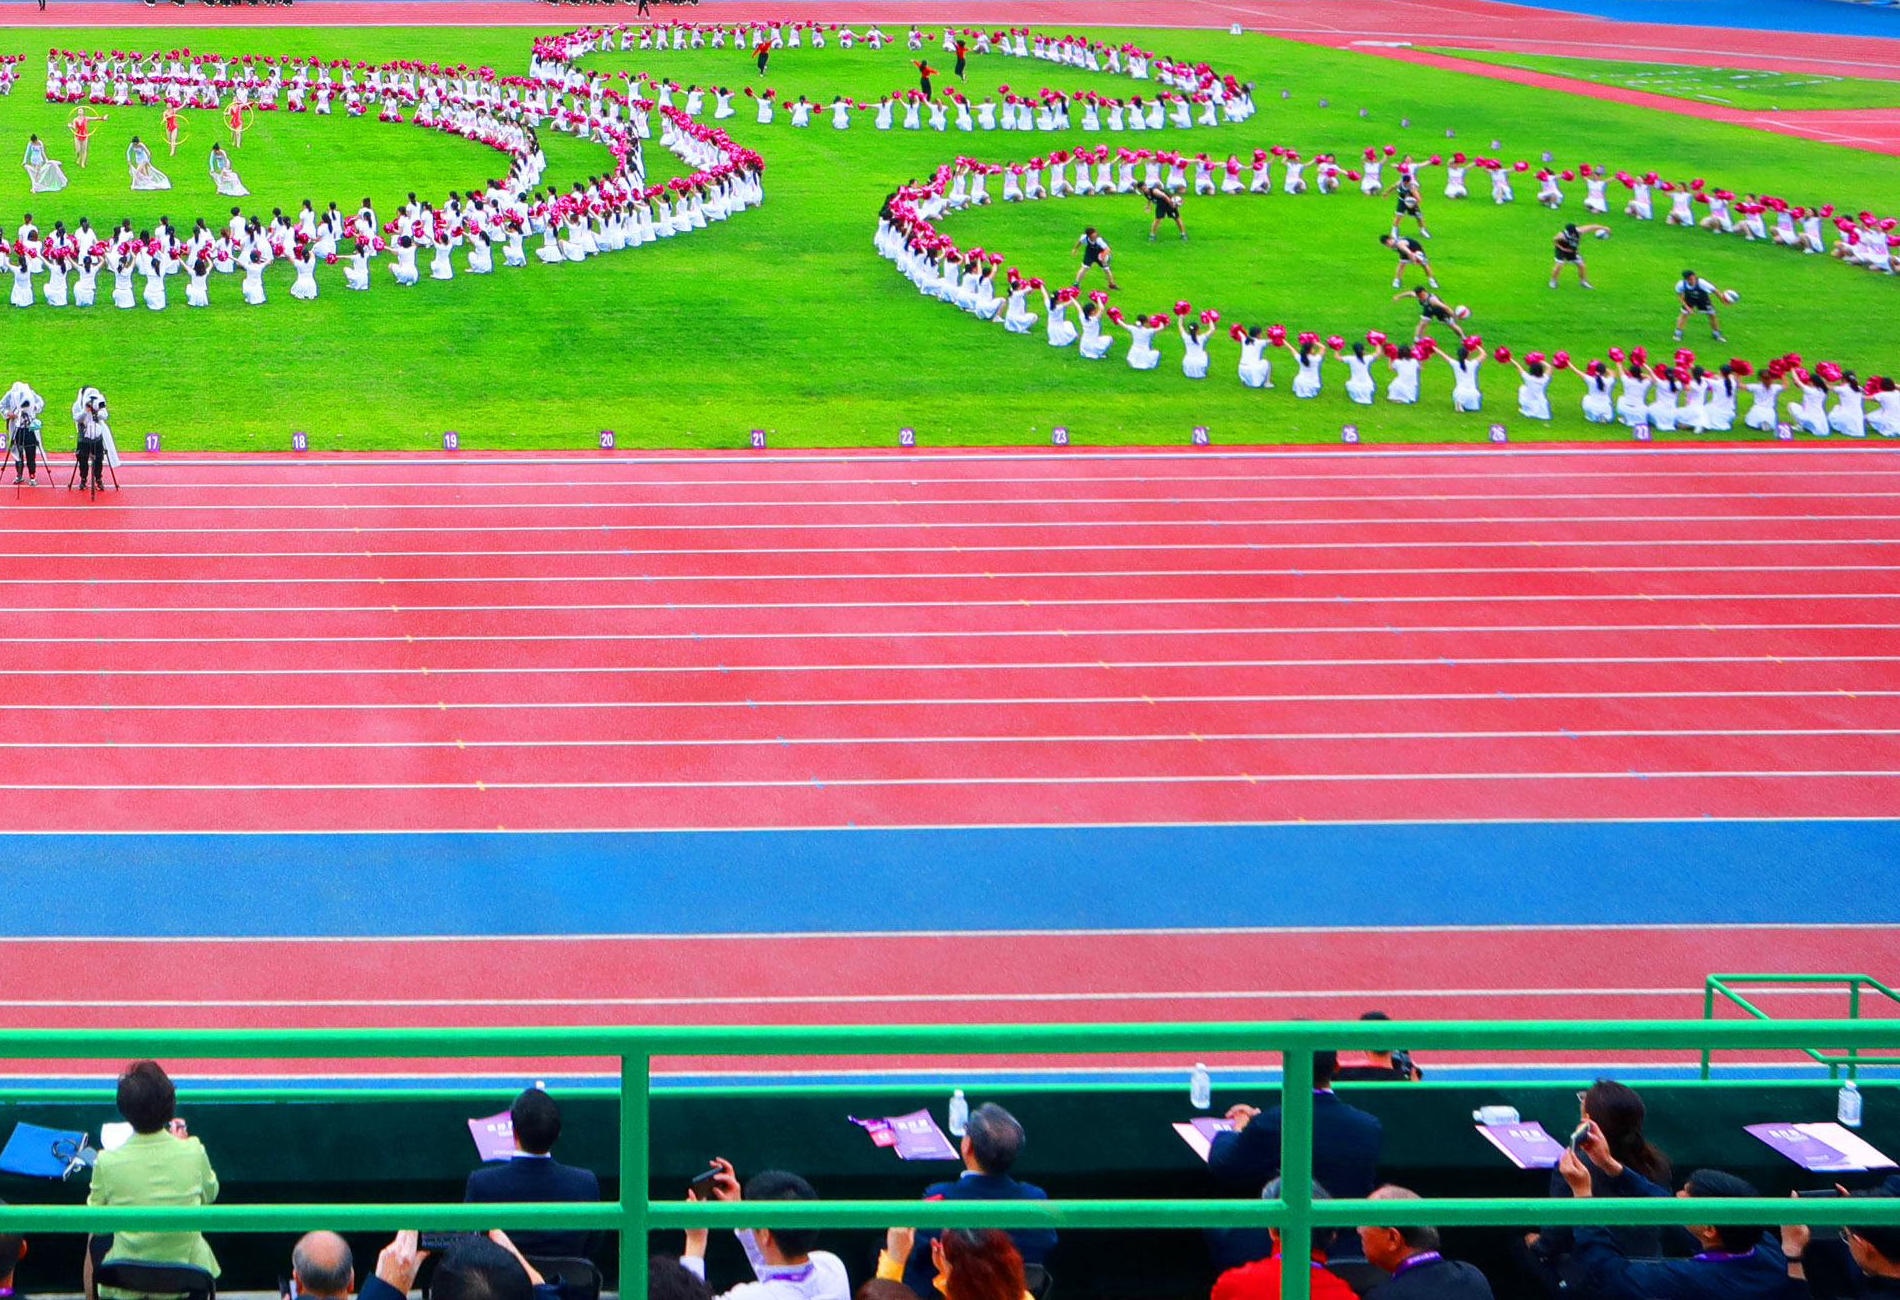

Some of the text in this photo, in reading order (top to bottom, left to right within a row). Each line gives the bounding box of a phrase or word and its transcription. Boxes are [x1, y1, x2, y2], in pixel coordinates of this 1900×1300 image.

[293, 435, 306, 448] 18
[444, 434, 457, 448] 19
[601, 433, 613, 447] 20
[752, 432, 764, 446] 21
[901, 431, 913, 444] 22
[1054, 429, 1067, 443] 23
[1194, 429, 1208, 443] 24
[1344, 427, 1358, 442] 25
[146, 436, 158, 449] 17
